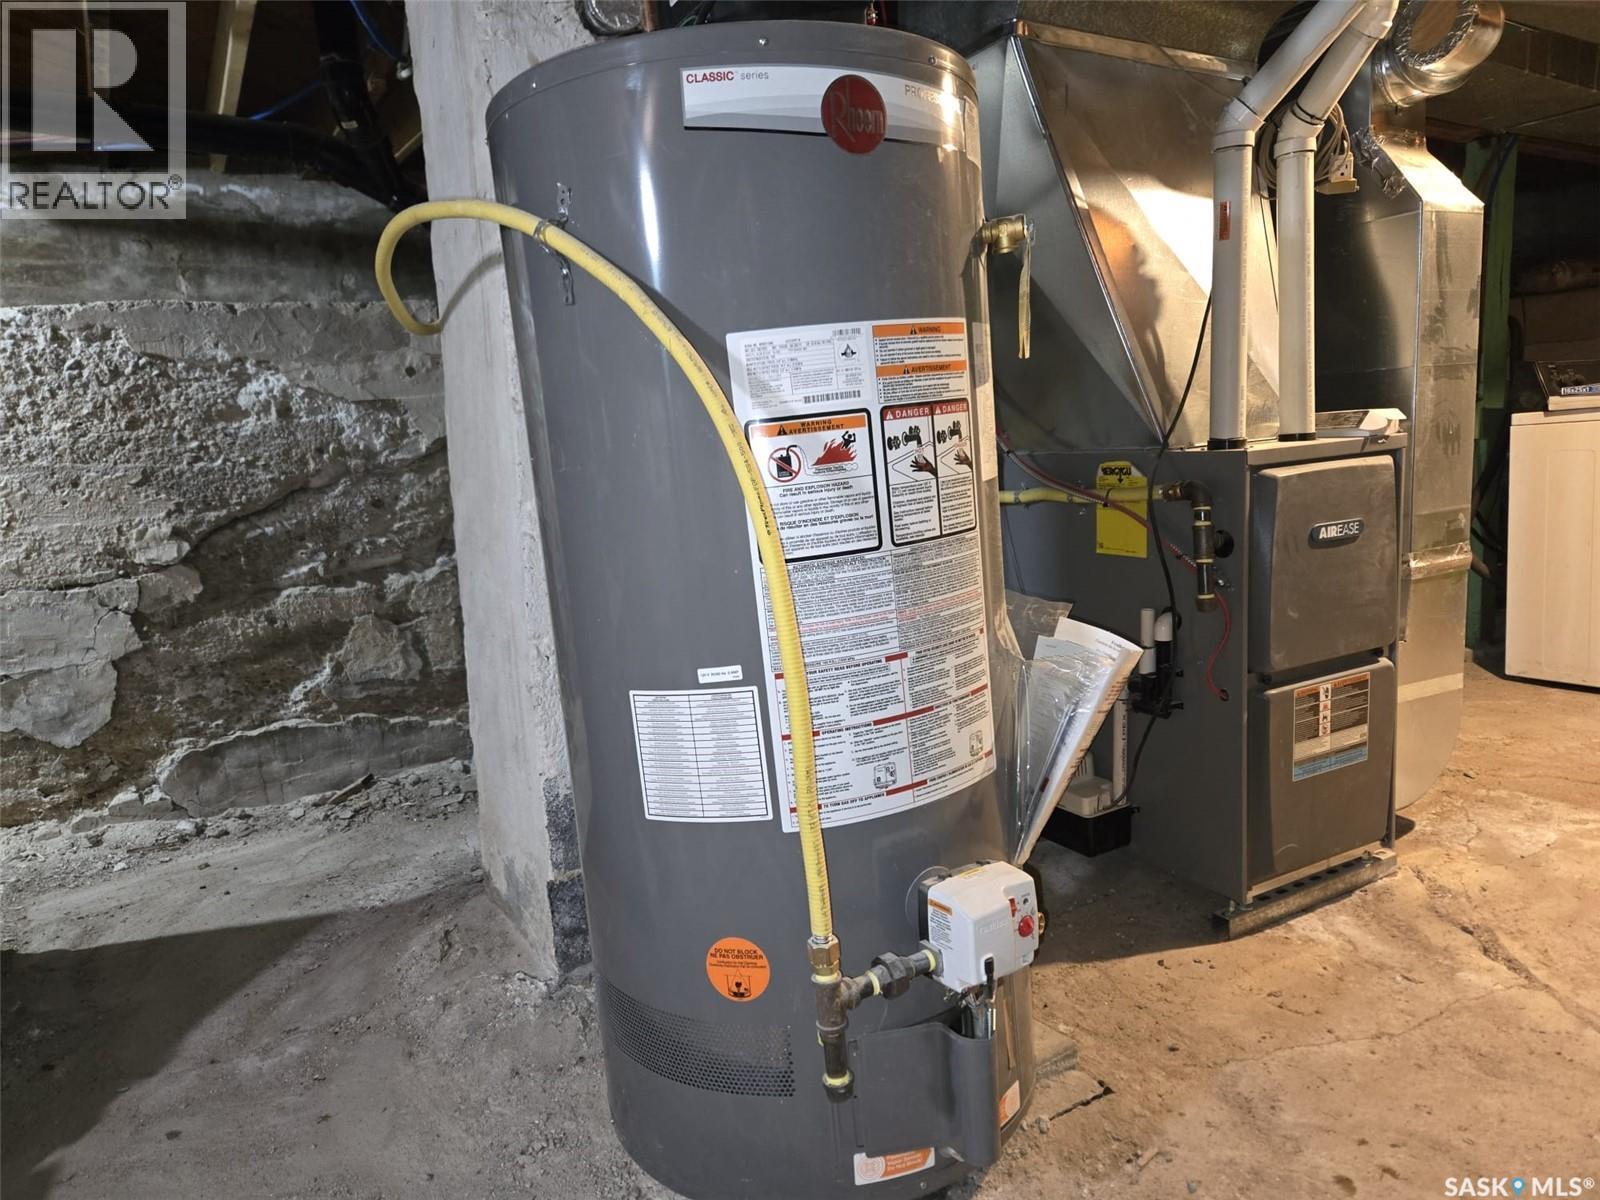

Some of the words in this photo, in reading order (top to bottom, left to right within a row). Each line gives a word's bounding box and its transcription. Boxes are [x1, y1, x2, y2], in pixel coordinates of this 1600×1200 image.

[686, 71, 734, 84] CLASSIC
[740, 71, 769, 81] series
[828, 84, 885, 142] Rheem
[918, 326, 941, 334] WARNING
[911, 364, 951, 373] AVERTISSEMENT
[895, 407, 930, 418] DANGER
[942, 403, 968, 413] DANGER
[800, 419, 832, 428] WARNING
[789, 424, 844, 435] AVERTISSEMENT
[1319, 522, 1360, 539] AIREASE
